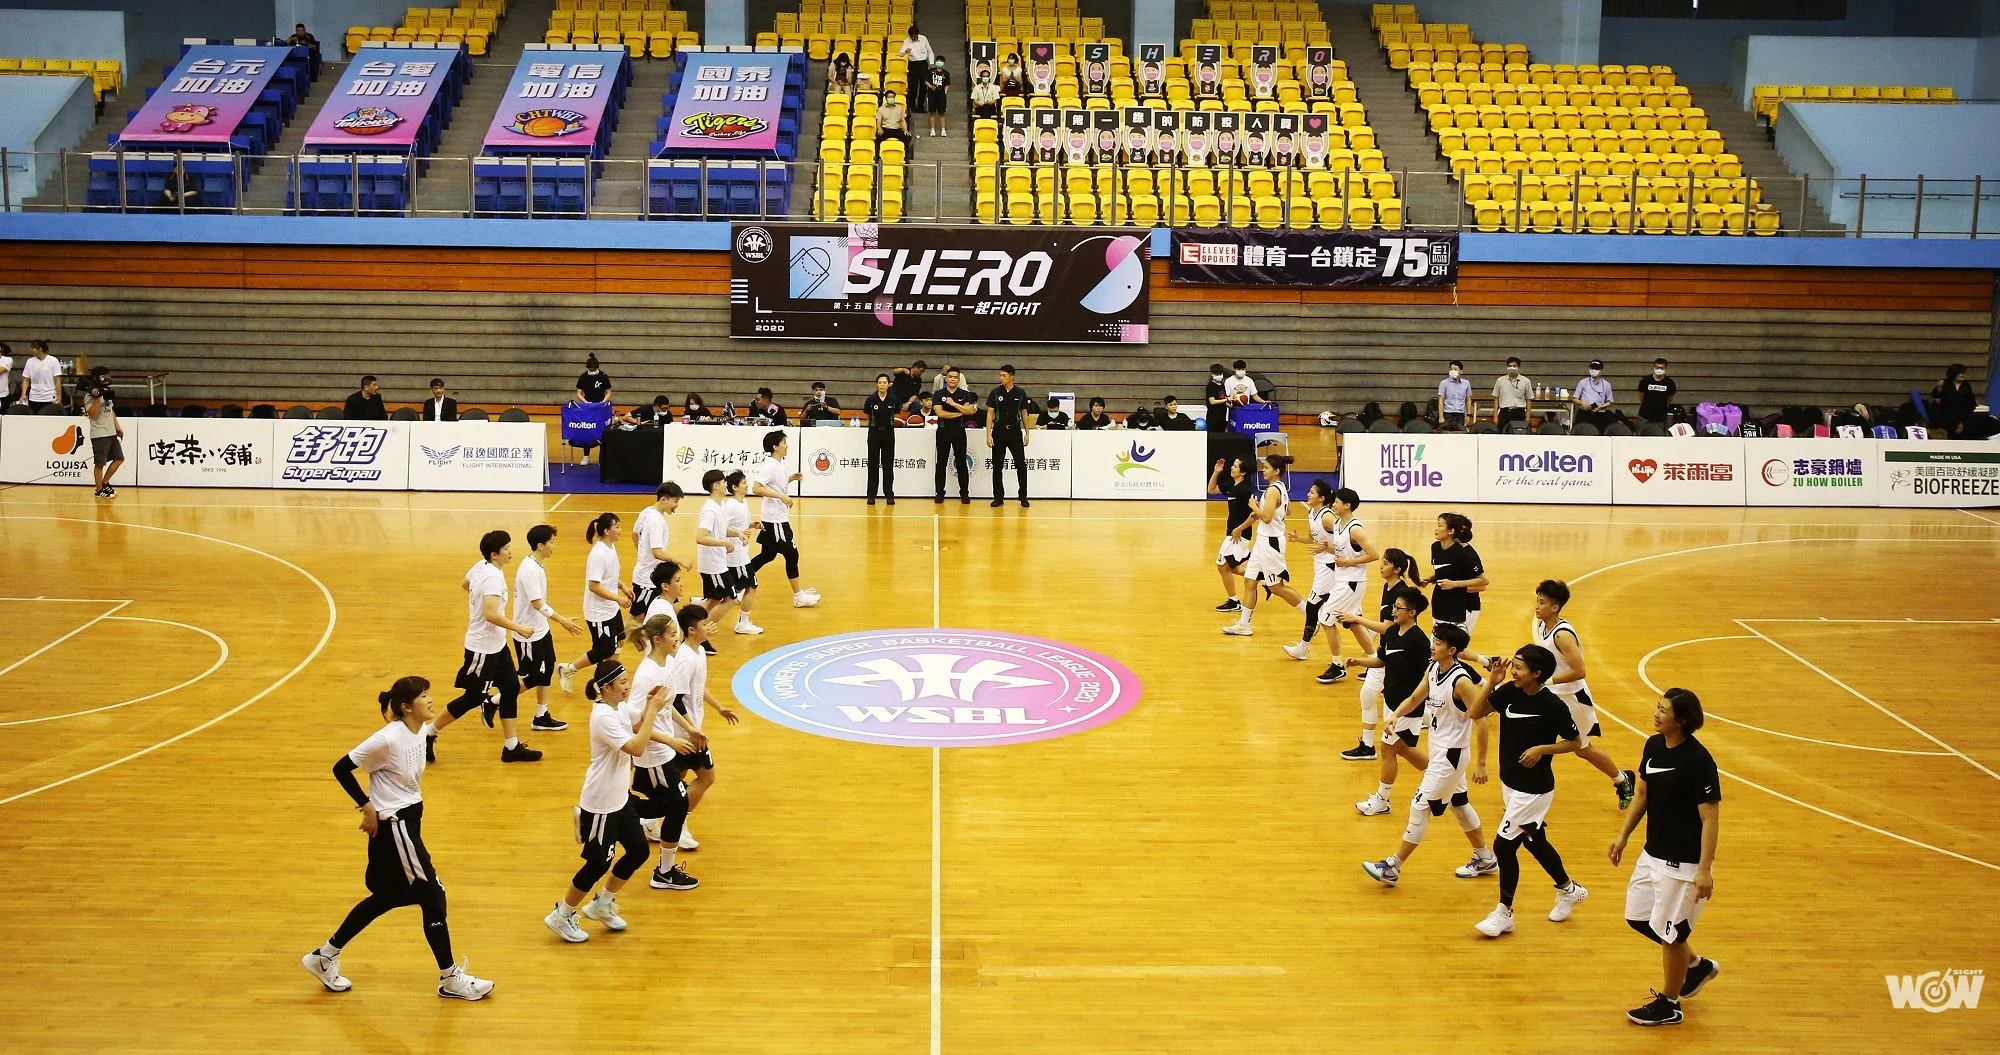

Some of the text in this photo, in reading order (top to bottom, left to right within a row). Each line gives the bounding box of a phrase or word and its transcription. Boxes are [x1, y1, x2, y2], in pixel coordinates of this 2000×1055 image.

[187, 58, 267, 75] 台元
[359, 61, 437, 77] 台電
[528, 63, 604, 79] 電信
[696, 65, 772, 81] 國泰
[172, 77, 253, 94] 加油
[347, 80, 427, 96] 加油
[518, 82, 597, 98] 加油
[692, 84, 768, 101] 加油
[1202, 246, 1236, 255] ELEVEN
[1243, 238, 1429, 277] 體育一台鎖定 75
[1202, 255, 1236, 263] SPORTS
[840, 249, 1053, 296] SHERO
[1431, 265, 1448, 276] CH
[755, 324, 785, 332] 2020
[569, 421, 597, 429] molten
[287, 426, 387, 464] 舒跑
[463, 447, 533, 459] 展逸國際企業
[47, 460, 88, 469] LOUISA
[840, 457, 927, 469] 中華民球協會
[1381, 444, 1415, 469] MEET
[1499, 451, 1592, 472] molten
[283, 466, 381, 482] Super Supau
[1663, 463, 1732, 481] 萊爾富
[1793, 459, 1862, 475] 志豪鍋爐
[1379, 464, 1443, 493] agile
[1496, 476, 1592, 489] For the real game
[1793, 478, 1863, 487] ZU HOW BOILER
[1914, 478, 2000, 495] BIOFREEZE
[773, 637, 1101, 703] WOMEN'S SUPER BASKETBALL LEAGUE 2020
[836, 705, 1049, 725] WSBL
[1502, 820, 1511, 834] 2
[1665, 920, 1672, 936] 6
